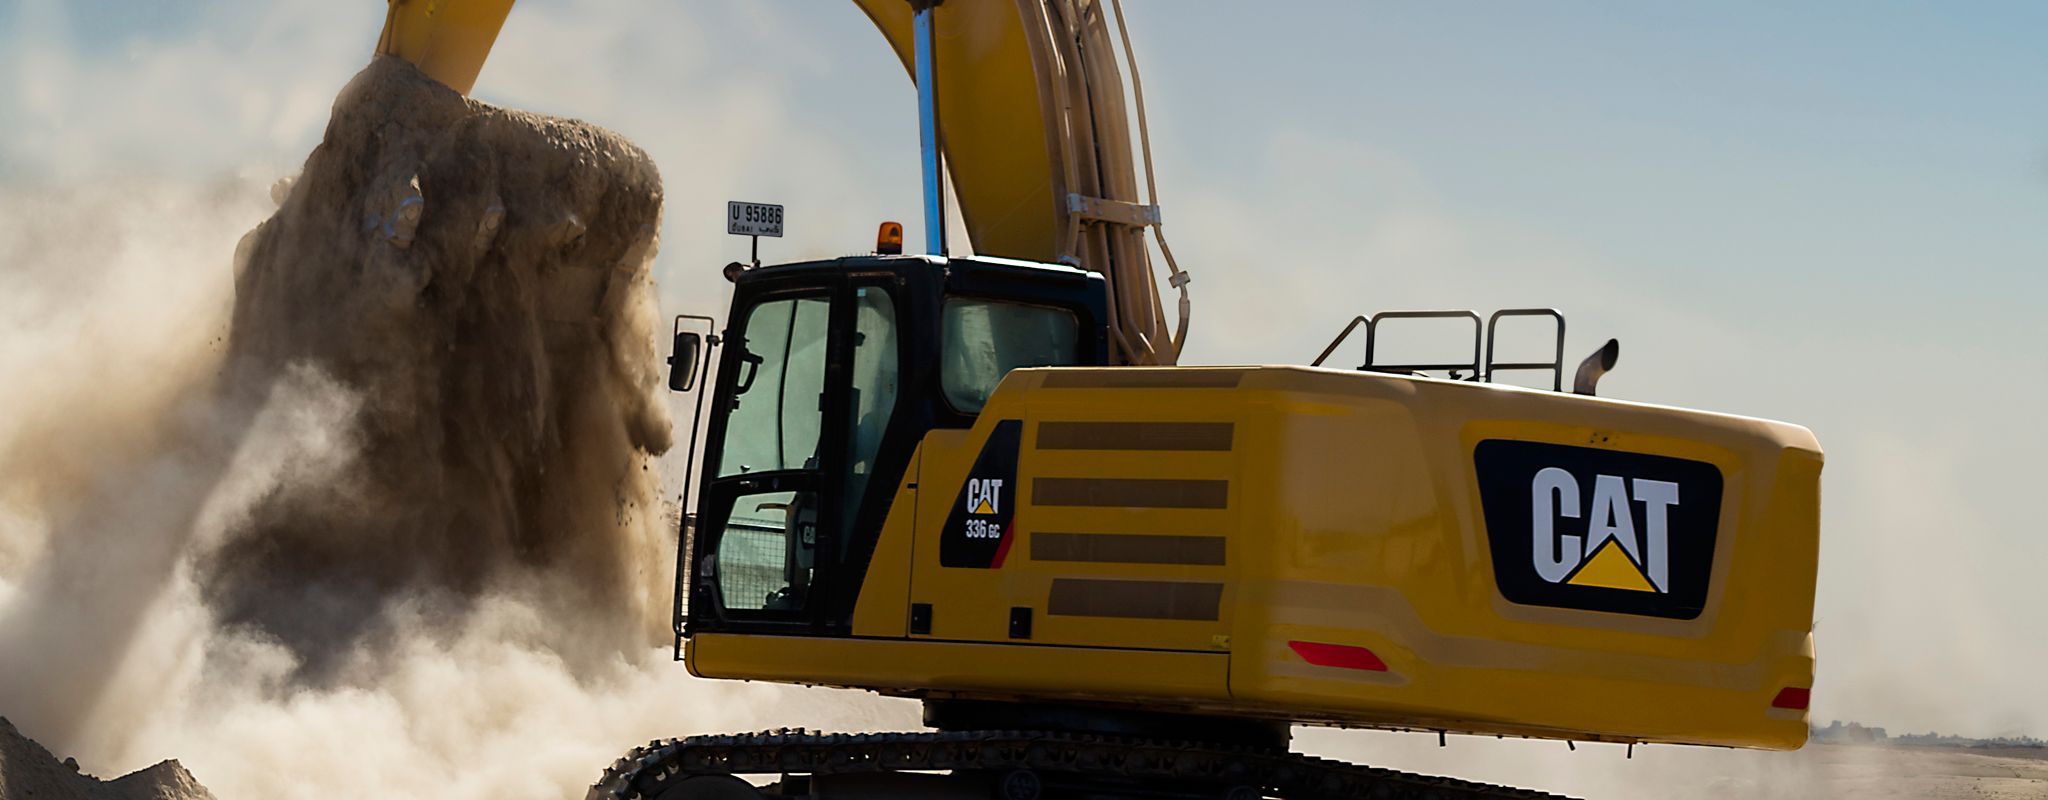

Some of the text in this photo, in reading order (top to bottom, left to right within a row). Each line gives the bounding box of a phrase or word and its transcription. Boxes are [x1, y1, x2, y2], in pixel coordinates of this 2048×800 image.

[733, 205, 782, 224] U 95886
[967, 478, 1003, 514] CAT
[966, 519, 1000, 538] 336 GC
[1532, 467, 1679, 593] CAT
